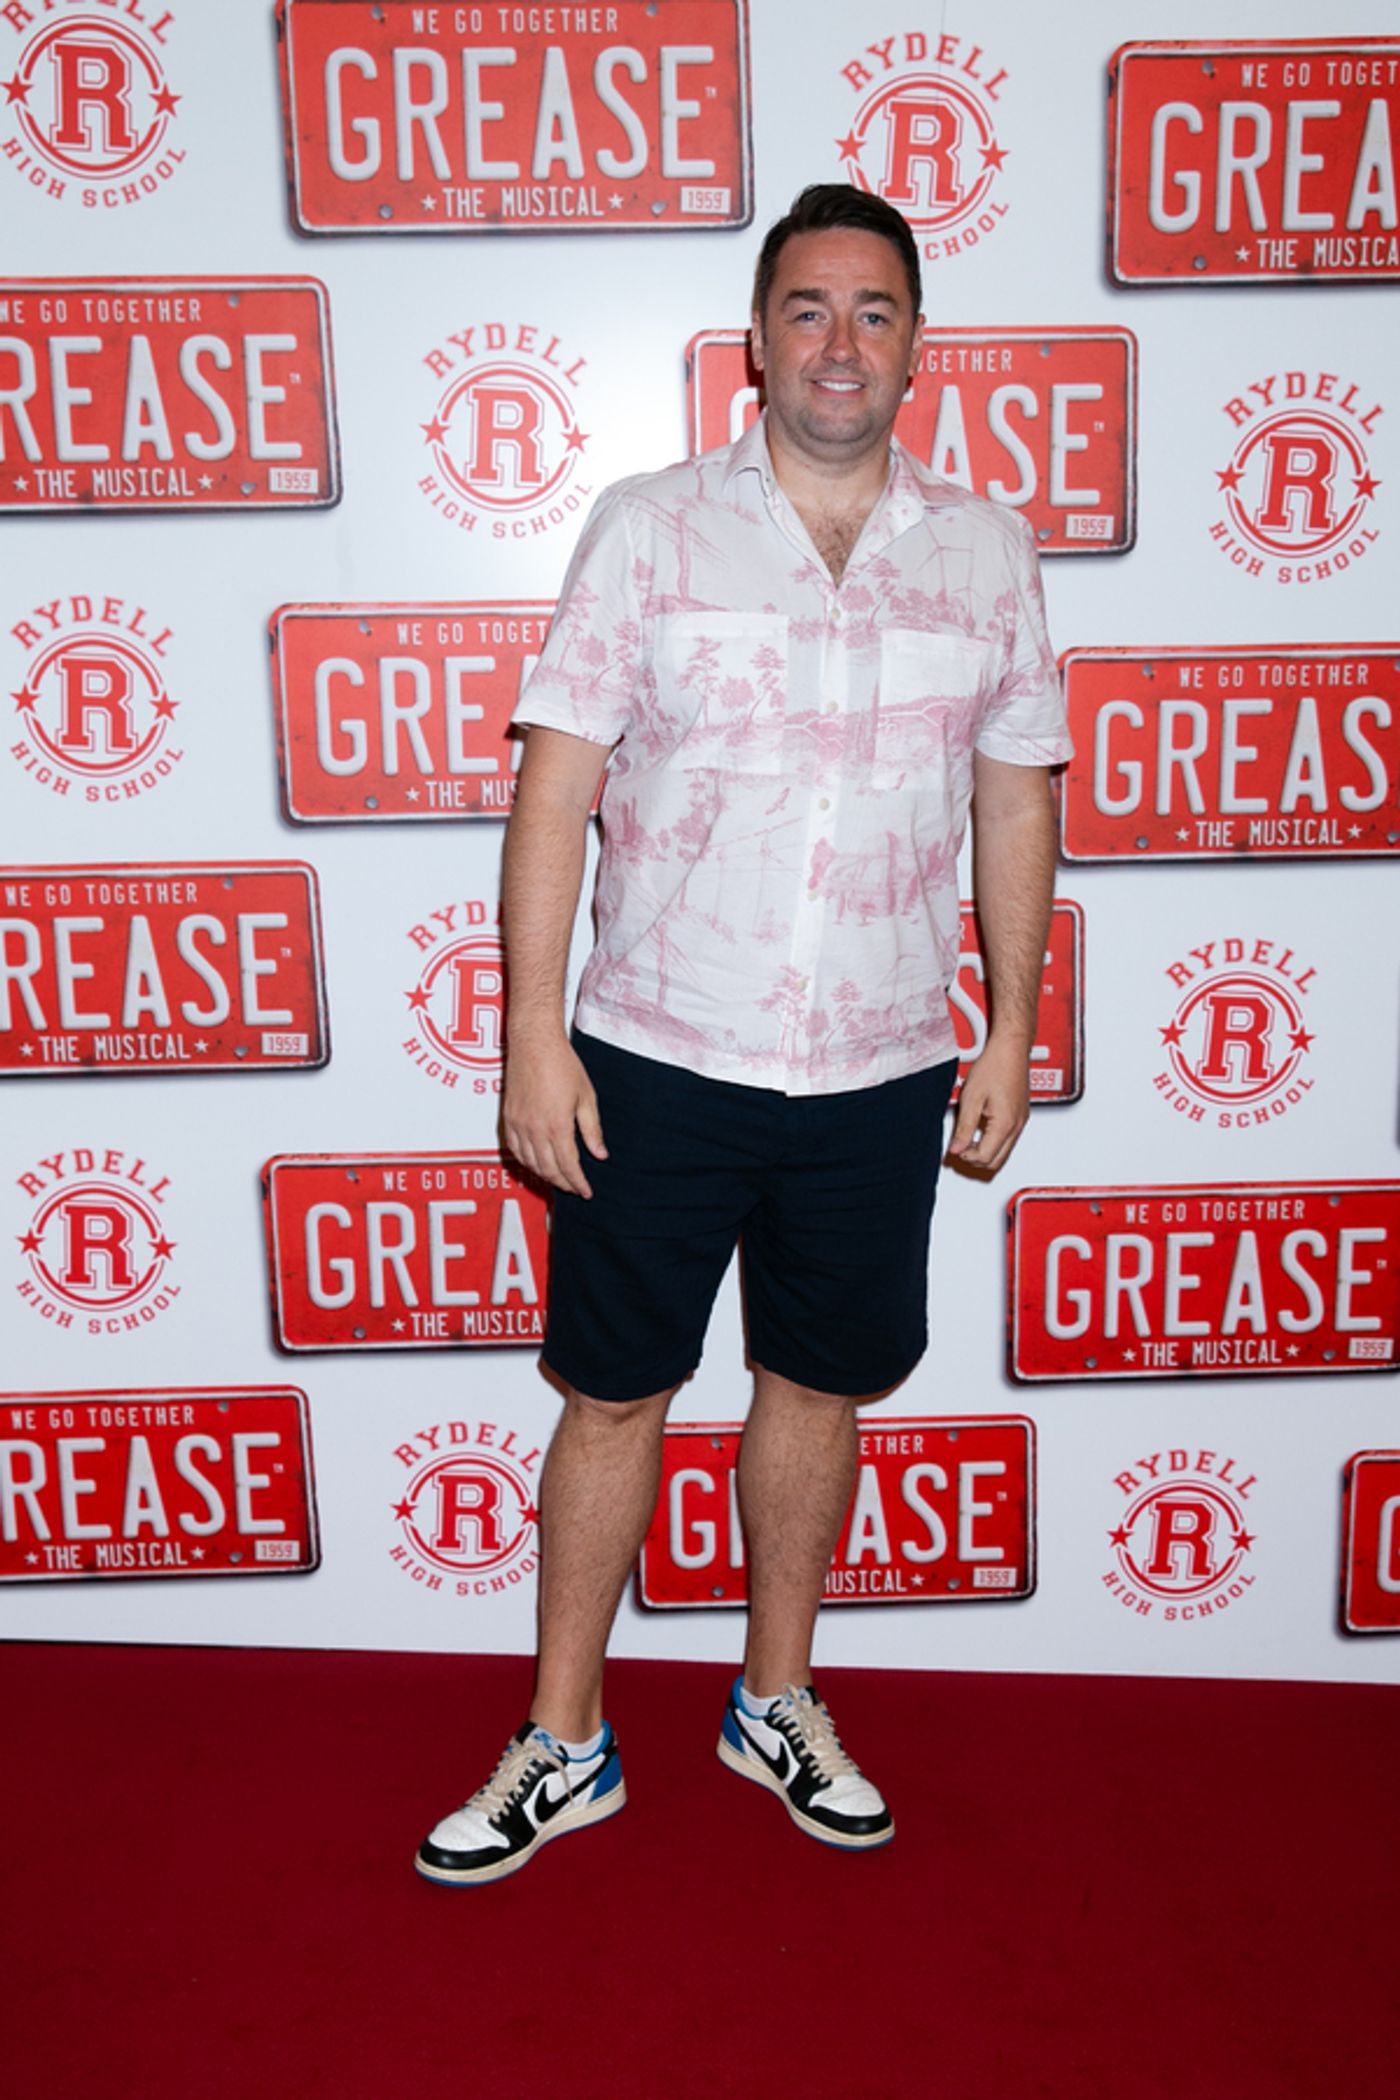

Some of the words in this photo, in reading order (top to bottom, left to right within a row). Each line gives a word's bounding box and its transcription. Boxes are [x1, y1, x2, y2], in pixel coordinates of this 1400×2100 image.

[0, 0, 174, 45] RLL
[413, 10, 438, 34] WE
[455, 9, 482, 33] GO
[498, 8, 617, 33] TOGETHER
[840, 32, 1009, 101] RYDELL
[1242, 64, 1268, 87] WE
[1283, 63, 1310, 87] GO
[326, 46, 715, 180] GREASE
[2, 138, 66, 199] HIGH
[82, 149, 187, 208] SCHOOL
[443, 188, 485, 218] THE
[502, 186, 604, 217] MUSICAL
[687, 191, 723, 210] 1959
[924, 203, 1009, 261] CHOOL
[1257, 239, 1298, 268] THE
[40, 299, 67, 323] GO
[82, 299, 201, 322] TOGETHER
[422, 322, 587, 387] RYDELL
[918, 349, 1012, 373] GETHER
[1222, 371, 1384, 436] RYDELL
[34, 469, 77, 498] THE
[92, 468, 194, 496] MUSICAL
[277, 471, 311, 488] 1959
[418, 475, 478, 531] HIGH
[492, 484, 593, 539] SCHOOL
[1073, 518, 1106, 537] 1959
[1209, 520, 1265, 577] HIGH
[1278, 528, 1380, 584] SCHOOL
[10, 595, 174, 658] RYDELL
[398, 623, 422, 645] WE
[438, 622, 463, 644] GO
[478, 621, 548, 645] TOGET
[1180, 667, 1203, 688] WE
[1218, 665, 1243, 687] GO
[1258, 664, 1368, 686] TOGETHER
[314, 656, 541, 778] GRE
[10, 740, 71, 796] HIGH
[86, 749, 184, 802] SCHOOL
[425, 781, 466, 807] THE
[1195, 821, 1234, 847] THE
[1249, 819, 1343, 845] MUSICAL
[5, 885, 31, 906] WE
[45, 884, 71, 906] GO
[85, 882, 197, 904] TOGETHER
[406, 900, 505, 952] RYD
[1165, 938, 1317, 995] RYDELL
[39, 1036, 80, 1062] THE
[94, 1034, 190, 1060] MUSICAL
[268, 1036, 300, 1053] 1959
[403, 1037, 459, 1088] HIGH
[1030, 1071, 1055, 1087] 959
[1152, 1072, 1206, 1123] HIGH
[1218, 1078, 1315, 1128] SCHOOL
[16, 1148, 171, 1204] RYDELL
[383, 1171, 407, 1191] WE
[421, 1170, 446, 1190] GO
[1126, 1204, 1151, 1224] WE
[1162, 1202, 1186, 1223] GO
[1200, 1200, 1305, 1221] TOGETHER
[305, 1198, 552, 1310] GREA
[1045, 1228, 1386, 1339] GREASE
[16, 1279, 74, 1329] HIGH
[88, 1285, 181, 1334] SCHOOL
[410, 1312, 449, 1336] THE
[463, 1309, 547, 1335] MUSICA
[1141, 1342, 1178, 1366] THE
[1192, 1340, 1281, 1364] MUSICAL
[1354, 1341, 1388, 1358] 1959
[11, 1410, 36, 1429] WE
[49, 1408, 74, 1428] GO
[87, 1405, 194, 1427] TOGETHER
[393, 1421, 541, 1473] RYDELL
[861, 1436, 924, 1456] ETHER
[1112, 1449, 1258, 1500] RYDELL
[669, 1462, 1005, 1568] GASE
[43, 1545, 82, 1569] THE
[96, 1542, 188, 1567] MUSICAL
[261, 1543, 292, 1558] 1959
[389, 1544, 443, 1591] HIGH
[979, 1569, 1011, 1586] 1959
[1102, 1570, 1153, 1616] HIGH
[1164, 1574, 1256, 1621] SCHOOL
